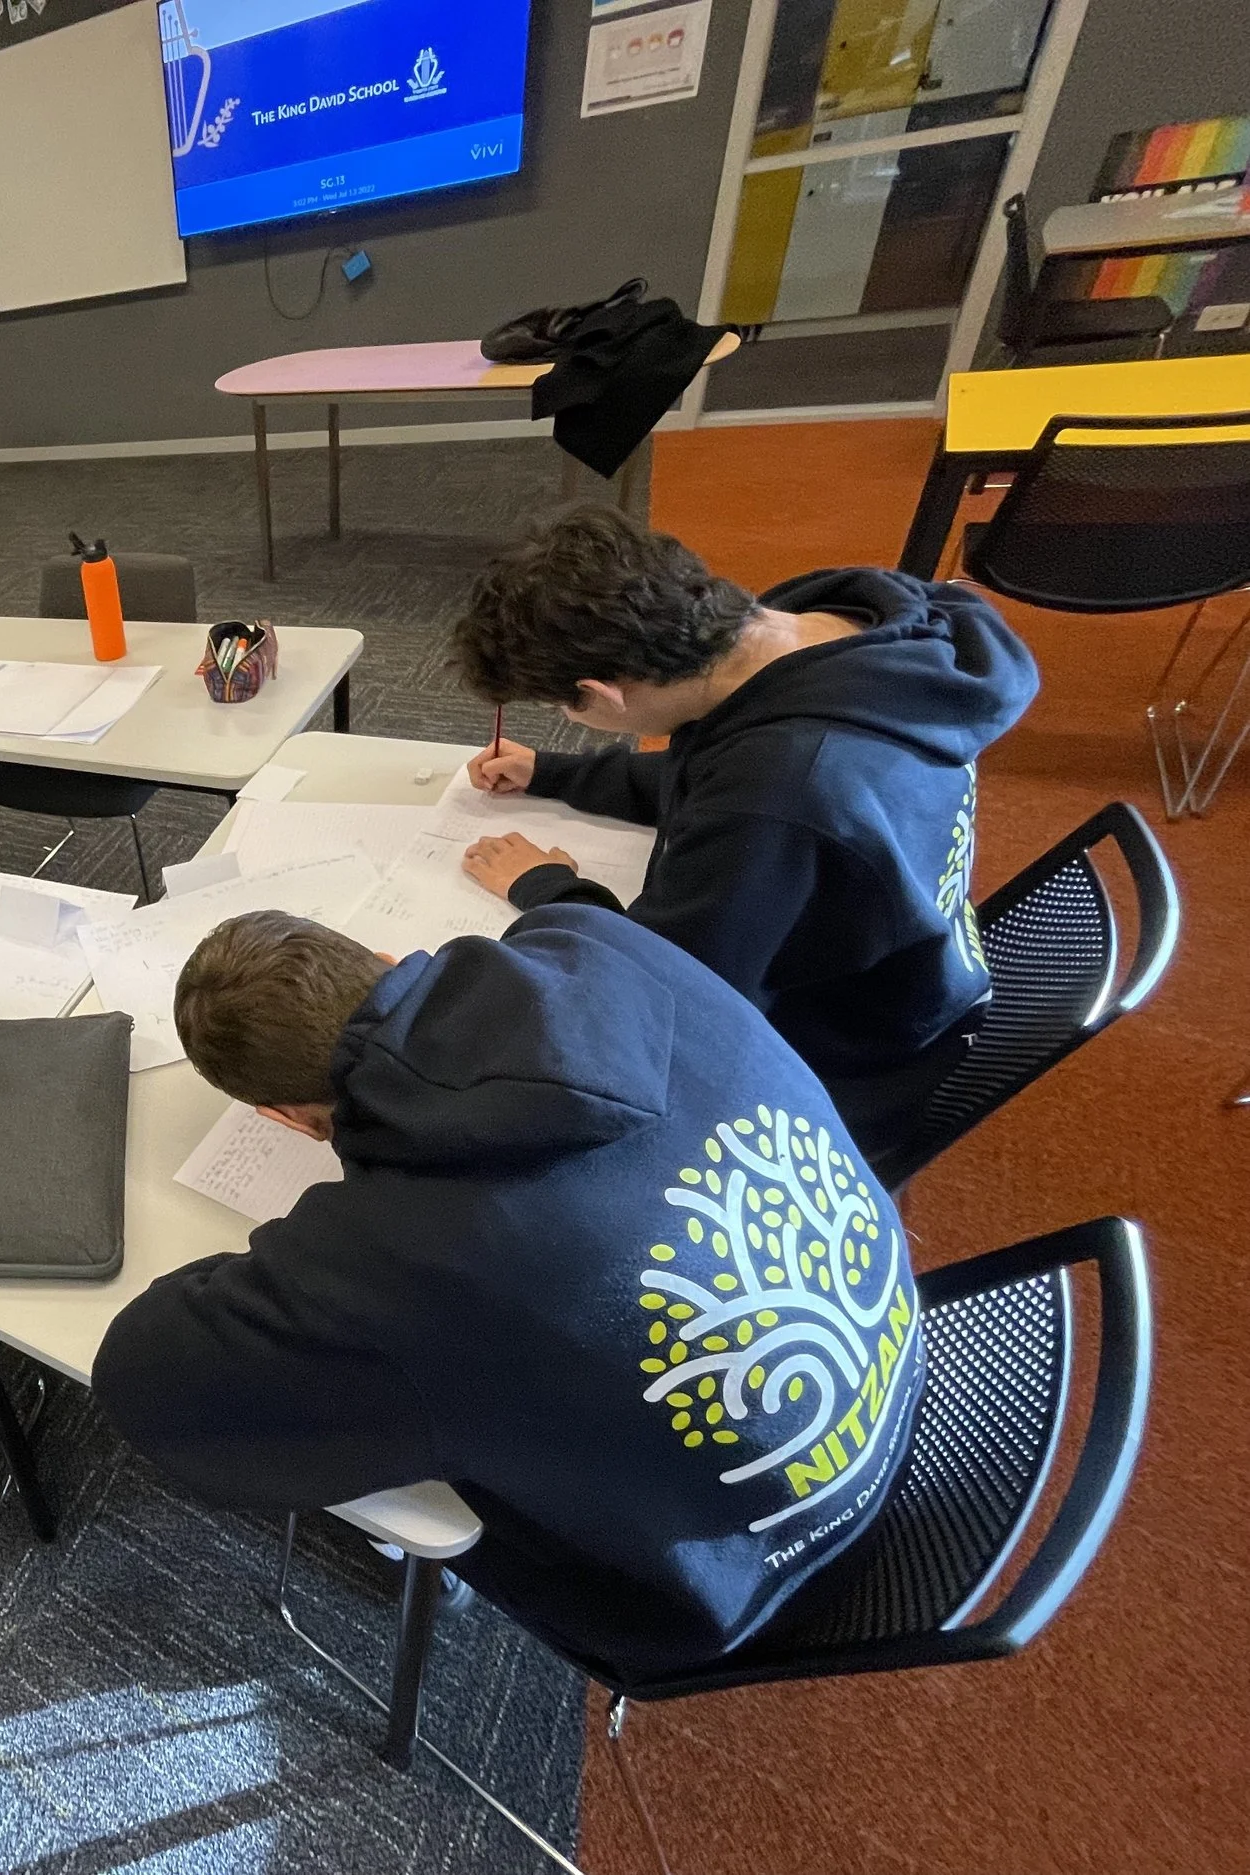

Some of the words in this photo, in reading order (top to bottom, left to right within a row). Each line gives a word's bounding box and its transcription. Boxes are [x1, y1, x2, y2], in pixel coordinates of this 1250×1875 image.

[320, 175, 346, 189] SG.13
[785, 1284, 912, 1498] NITZAN
[764, 1540, 806, 1568] THE
[810, 1508, 855, 1542] KING
